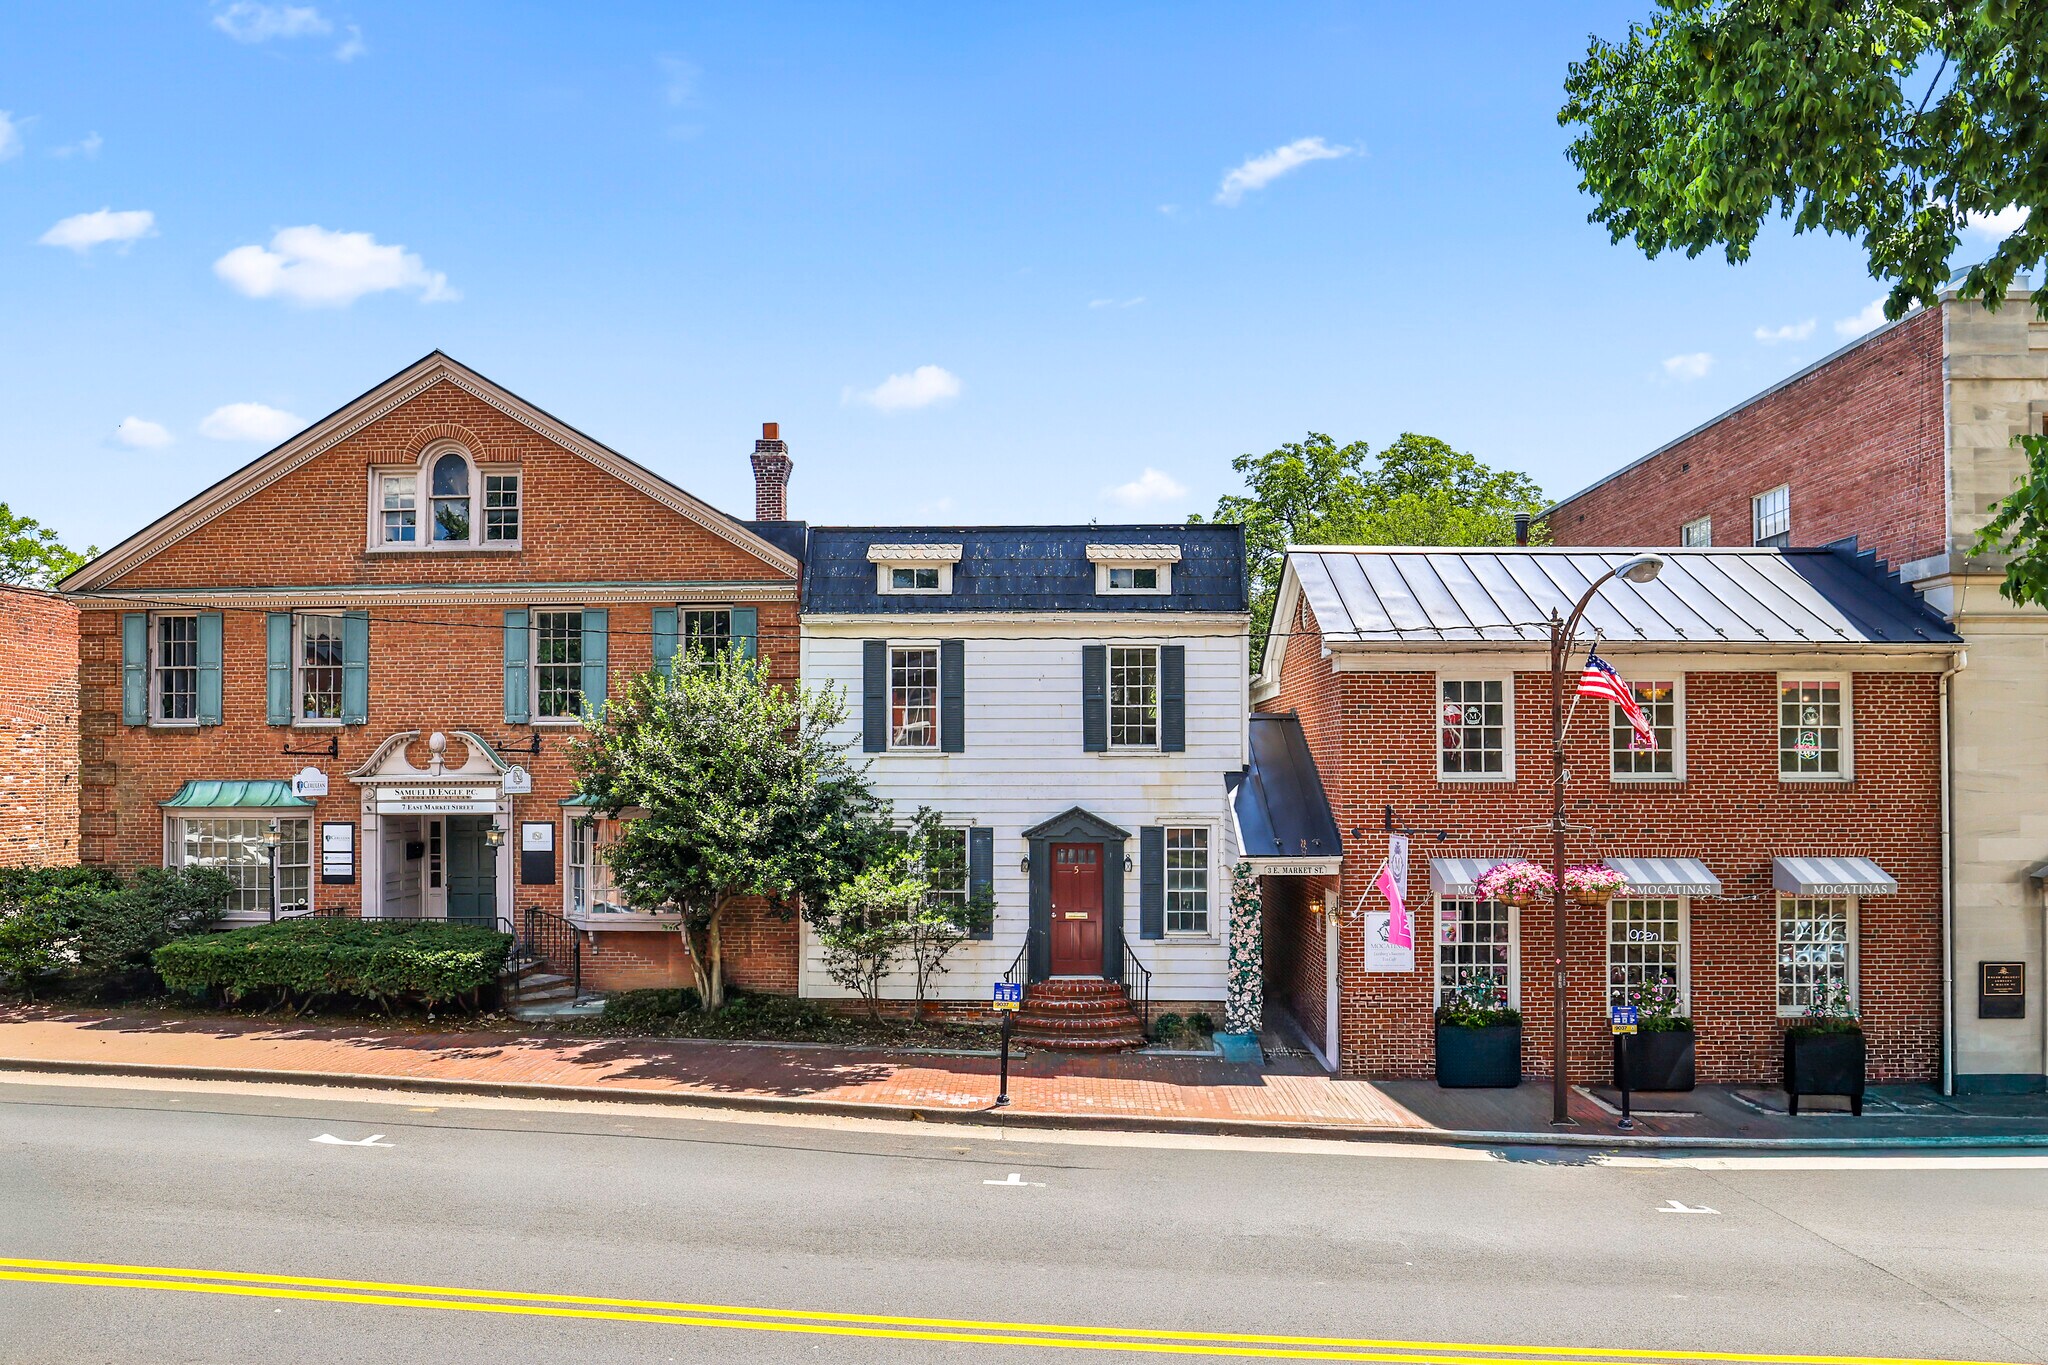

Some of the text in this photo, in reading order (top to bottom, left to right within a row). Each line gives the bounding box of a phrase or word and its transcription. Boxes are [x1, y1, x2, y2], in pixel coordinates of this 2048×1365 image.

[394, 788, 428, 796] SAMUEL
[428, 788, 436, 796] D.
[438, 788, 464, 796] ENGLE
[1073, 865, 1080, 875] 5
[1637, 884, 1711, 894] MOCATINAS
[1813, 884, 1888, 894] MOCATINAS
